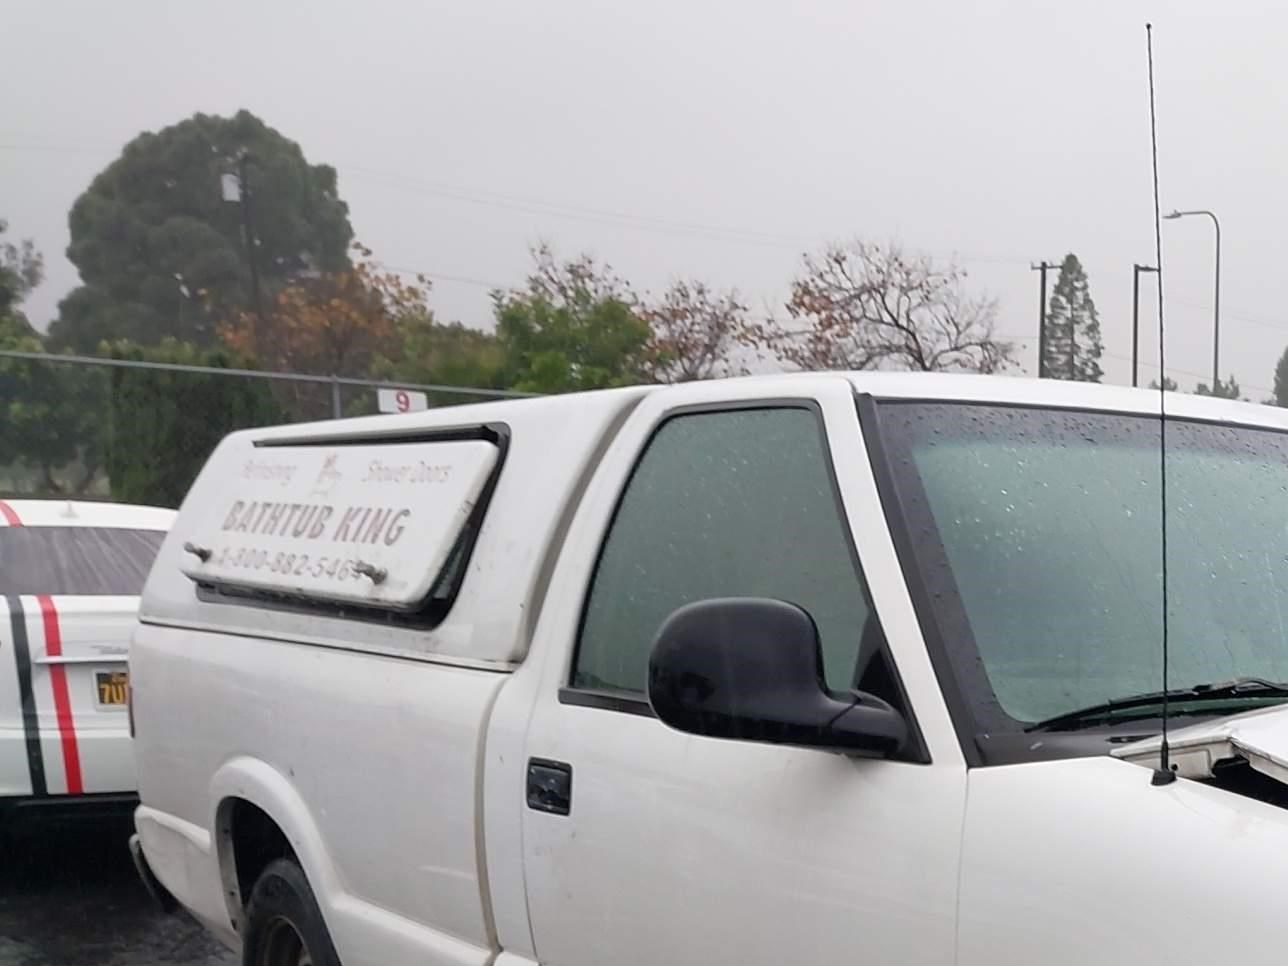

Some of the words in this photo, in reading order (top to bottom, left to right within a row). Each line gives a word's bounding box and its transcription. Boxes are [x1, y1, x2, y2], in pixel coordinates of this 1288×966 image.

[395, 391, 410, 412] 9
[221, 499, 333, 540] BATHTUB
[333, 506, 411, 546] KING
